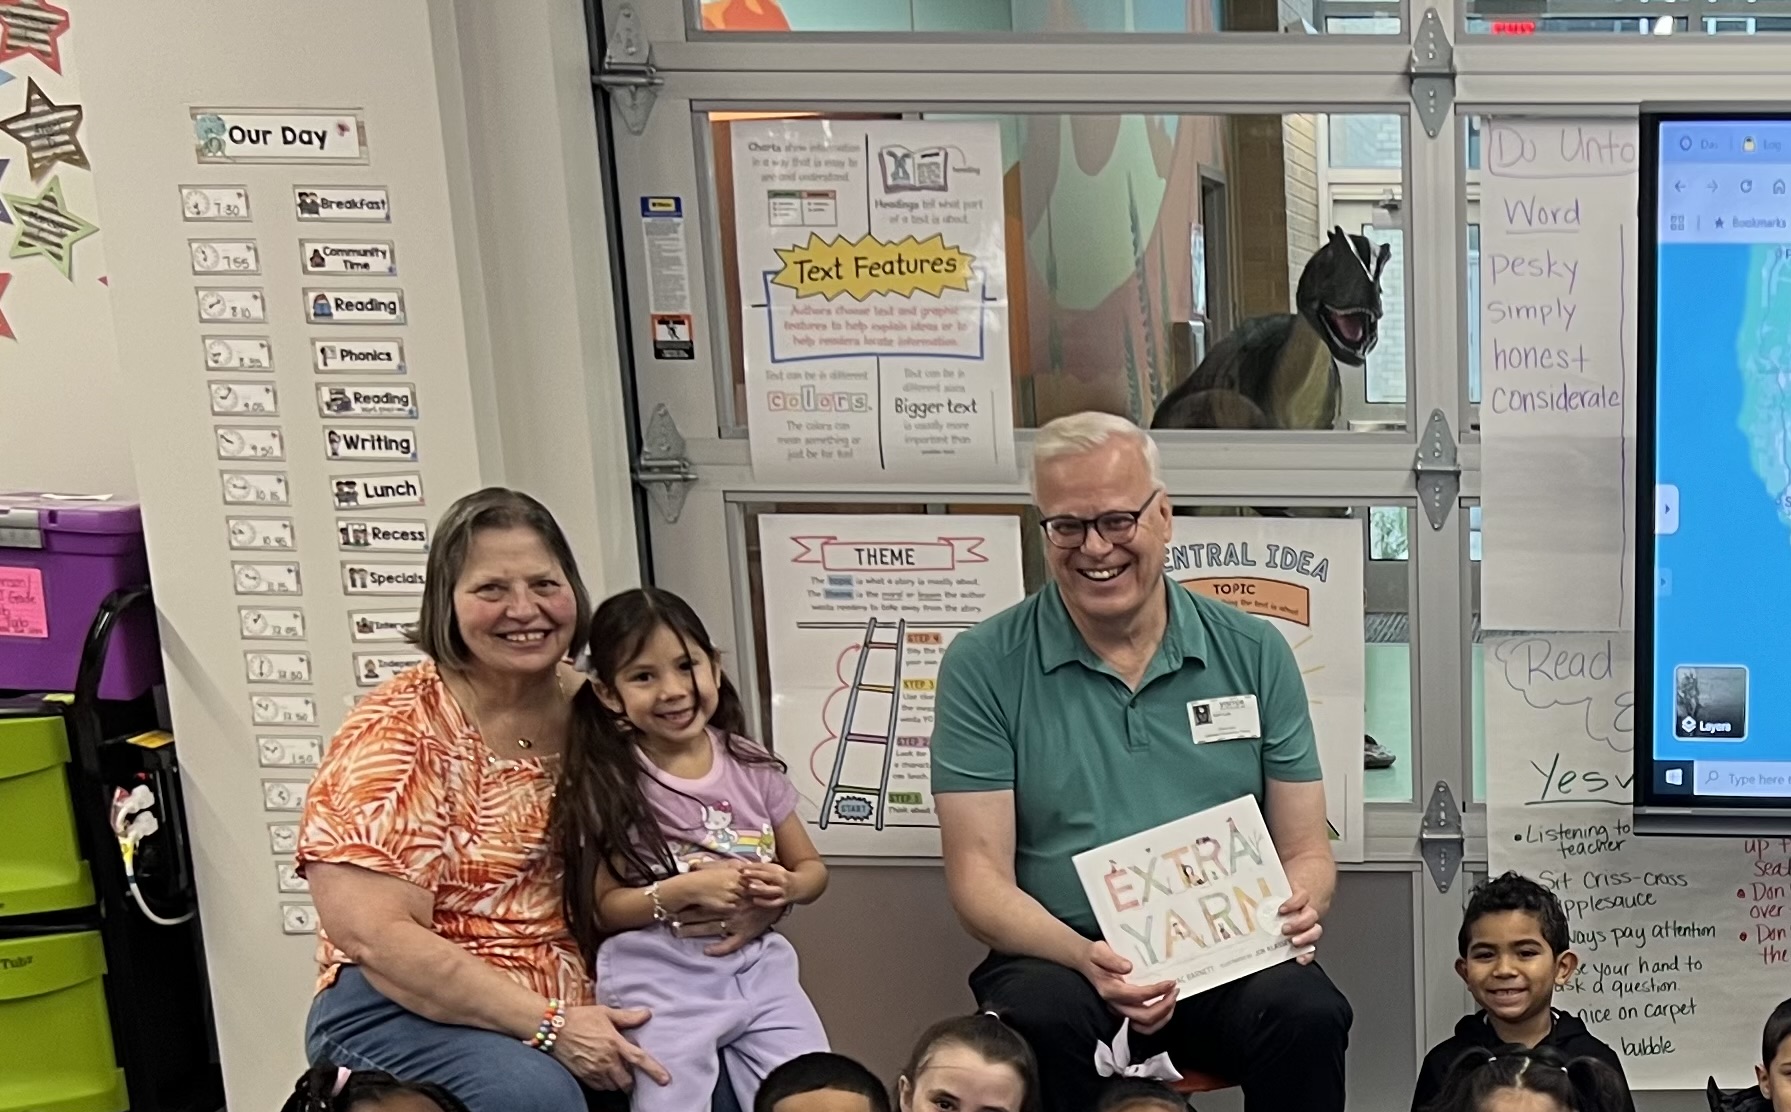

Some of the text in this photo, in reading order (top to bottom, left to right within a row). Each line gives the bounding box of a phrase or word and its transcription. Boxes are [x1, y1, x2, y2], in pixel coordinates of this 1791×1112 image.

[228, 125, 328, 150] Our Day
[1491, 125, 1636, 168] Do Unto
[321, 198, 386, 211] Breakfast
[1503, 195, 1582, 228] Word
[322, 246, 388, 260] Community
[343, 260, 371, 271] Time
[793, 252, 958, 284] Text Features
[334, 297, 397, 315] Reading
[340, 349, 393, 362] Phonics
[1493, 337, 1591, 374] honest
[353, 392, 410, 407] Reading
[894, 397, 978, 419] Bigger text
[343, 434, 411, 455] Writing
[363, 480, 418, 499] Lunch
[371, 527, 426, 542] Recess
[854, 547, 916, 567] THEME
[1163, 541, 1330, 583] ENTRAL IDEA
[370, 571, 425, 586] Specials
[1213, 582, 1257, 596] TOPIC
[1511, 637, 1613, 686] Read
[1698, 720, 1732, 735] Layers
[1529, 752, 1610, 801] Yes
[1728, 773, 1757, 788] Type
[1759, 773, 1785, 786] here
[1526, 818, 1631, 845] Listening to
[1556, 838, 1627, 860] teacher
[1744, 839, 1770, 861] up
[1103, 816, 1264, 914] EXTRA
[1539, 869, 1573, 890] Sit
[1120, 875, 1274, 968] YARN
[1749, 903, 1784, 919] over
[1611, 920, 1717, 950] pay attention
[1762, 944, 1790, 964] the
[1593, 954, 1703, 983] your hand to
[1554, 976, 1586, 993] ask
[1593, 978, 1605, 994] a
[1576, 999, 1698, 1026] nice on carpet
[1620, 1036, 1677, 1057] bubble
